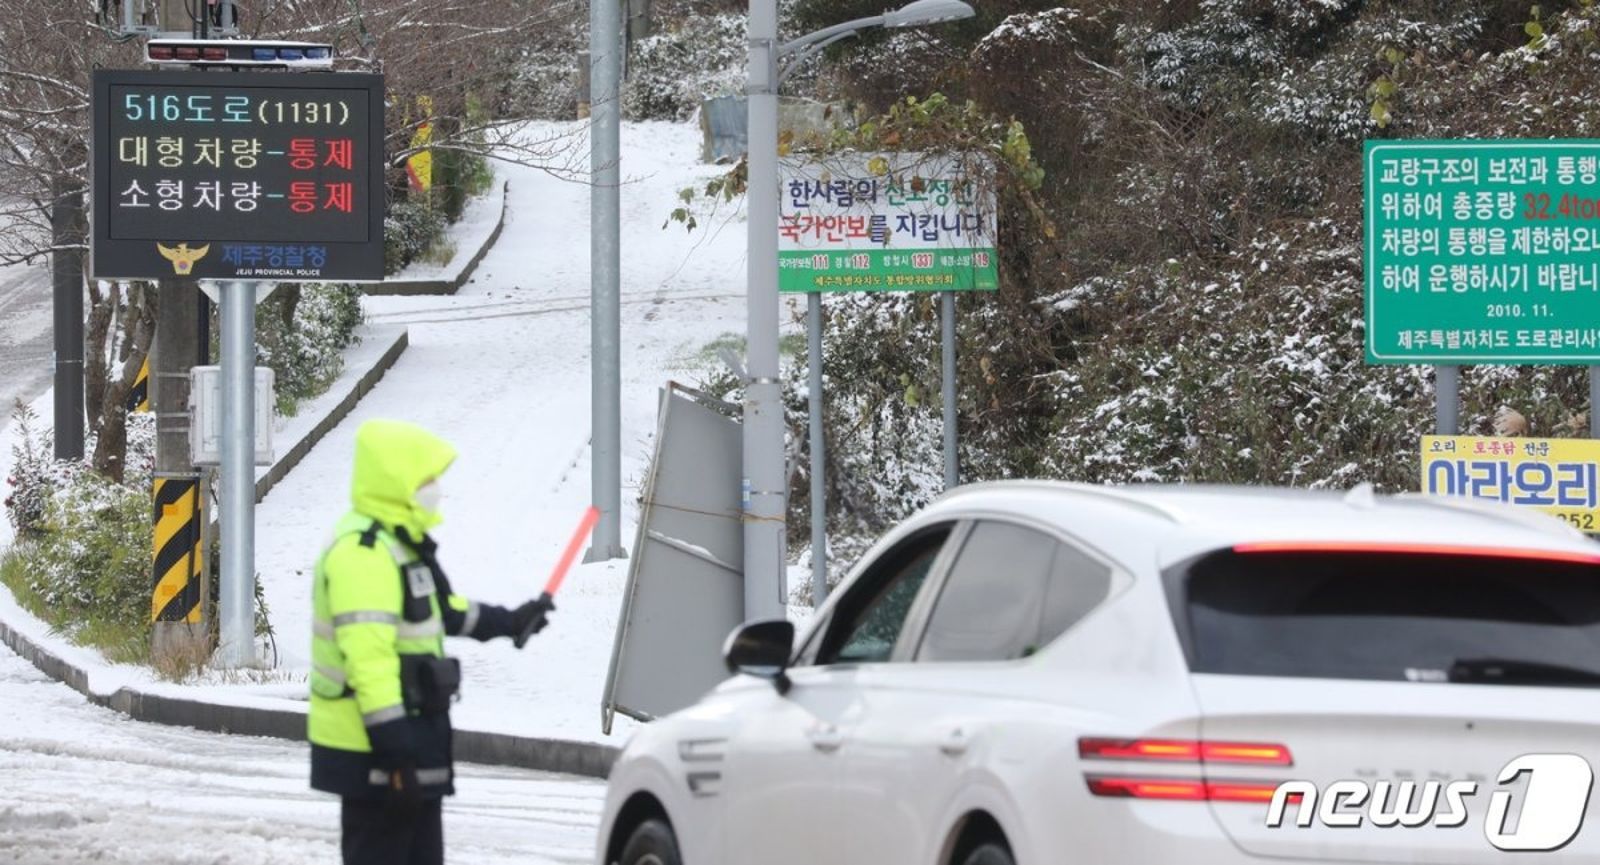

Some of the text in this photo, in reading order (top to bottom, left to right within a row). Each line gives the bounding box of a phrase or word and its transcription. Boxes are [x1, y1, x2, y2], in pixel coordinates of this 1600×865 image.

[1380, 156, 1600, 186] 교량구조의 보전과 통행
[788, 178, 878, 208] 한사람의
[1381, 192, 1443, 221] 위하여
[1452, 191, 1516, 221] 총중량
[779, 212, 984, 243] 국가안보를 지킵니다
[1382, 227, 1440, 256] 차량의
[1447, 227, 1507, 256] 통행을
[222, 245, 326, 267] 제주경찰청
[812, 254, 829, 270] 111
[851, 253, 870, 270] 112
[912, 253, 934, 268] 1337
[235, 268, 320, 277] JEJU PROVINCIAL POLICE
[1382, 264, 1420, 293] 하여
[1428, 264, 1528, 293] 운행하시기
[1486, 304, 1554, 317] 2010. 11.
[1398, 329, 1600, 349] 제주특별자치도 도로관리사
[1429, 440, 1456, 453] 오리
[1523, 442, 1550, 456] 전문
[1428, 459, 1597, 508] 아라오리
